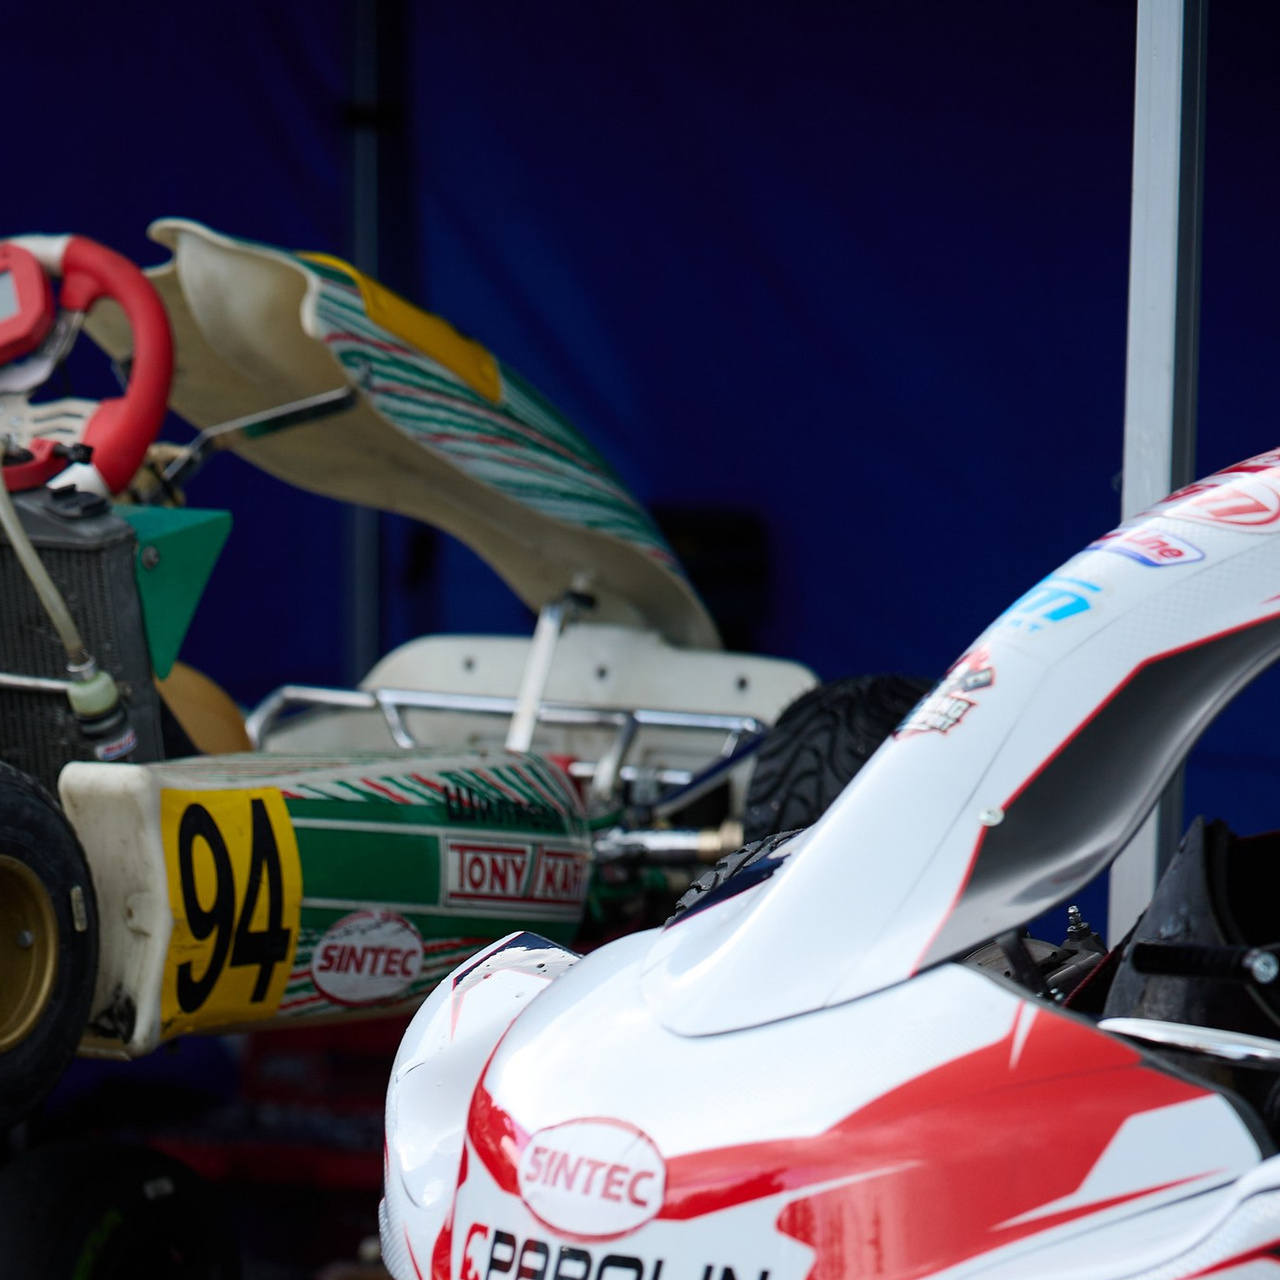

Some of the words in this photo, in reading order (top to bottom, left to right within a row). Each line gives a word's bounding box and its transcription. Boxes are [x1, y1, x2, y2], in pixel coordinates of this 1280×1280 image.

[451, 845, 527, 892] TONY
[177, 798, 291, 1013] 94
[319, 943, 418, 978] SINTEC
[525, 1146, 655, 1208] SINTEC
